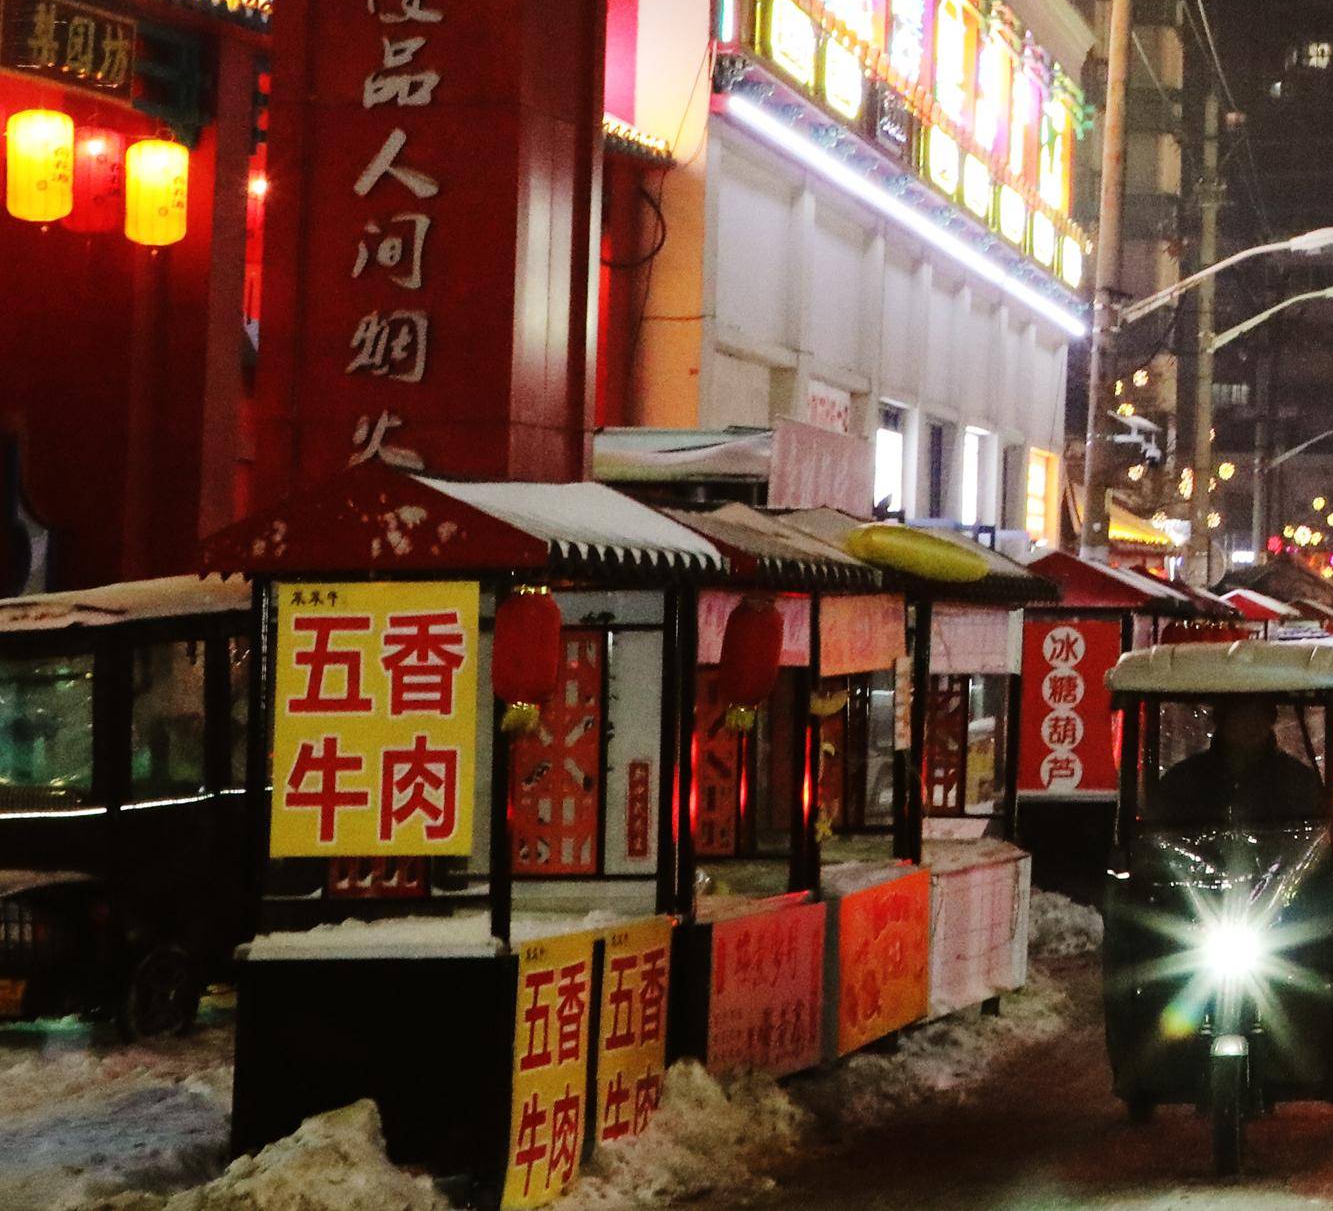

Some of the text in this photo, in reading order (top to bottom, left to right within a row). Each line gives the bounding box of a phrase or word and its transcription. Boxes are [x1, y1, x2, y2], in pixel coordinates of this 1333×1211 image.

[287, 612, 465, 716] 五香
[1043, 629, 1082, 789] 冰糖葫芦
[284, 735, 459, 842] 牛肉
[520, 960, 586, 1072] 五香
[605, 947, 666, 1051] 五香
[514, 1082, 581, 1198] 牛肉
